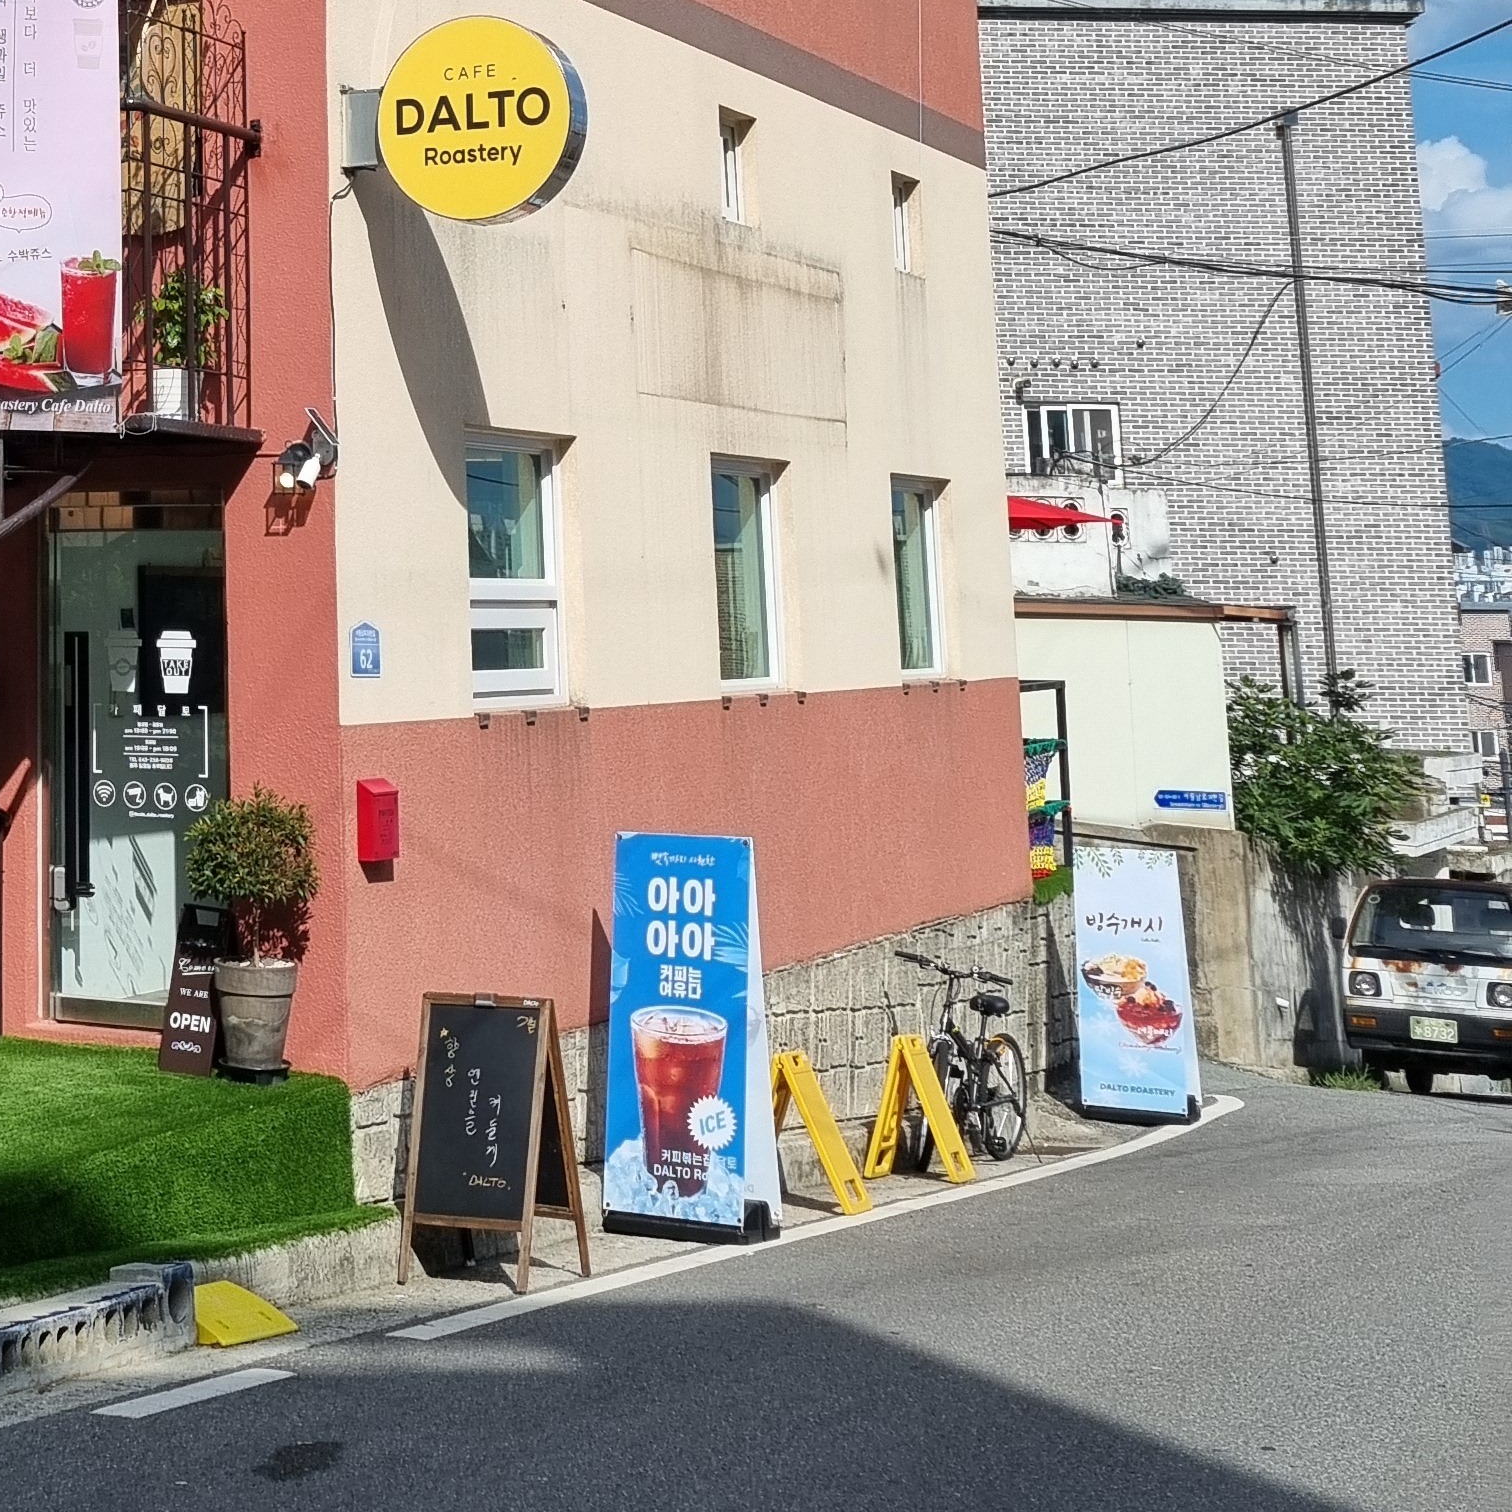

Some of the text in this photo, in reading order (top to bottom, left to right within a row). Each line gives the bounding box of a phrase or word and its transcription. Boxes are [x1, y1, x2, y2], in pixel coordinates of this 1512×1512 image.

[24, 61, 37, 78] 더
[444, 64, 496, 81] CAFE
[396, 87, 550, 135] DALTO
[23, 99, 38, 152] 맛있는
[424, 144, 522, 166] Roastery
[8, 248, 52, 262] 수박쥬스
[41, 398, 71, 414] Cafe
[73, 399, 112, 415] Dalto
[163, 659, 189, 668] TAKE
[360, 648, 373, 669] 62
[166, 668, 188, 676] OUT
[647, 876, 716, 917] 아아
[1086, 912, 1163, 935] 빙수개시
[646, 920, 716, 961] 아아
[660, 965, 702, 984] 커피는
[180, 987, 208, 999] WE ARE
[659, 982, 702, 1000] 여유다
[169, 1011, 211, 1033] OPEN
[1100, 1082, 1177, 1097] DALTO ROASTERY
[699, 1110, 727, 1136] ICE
[654, 1164, 691, 1179] DALTO
